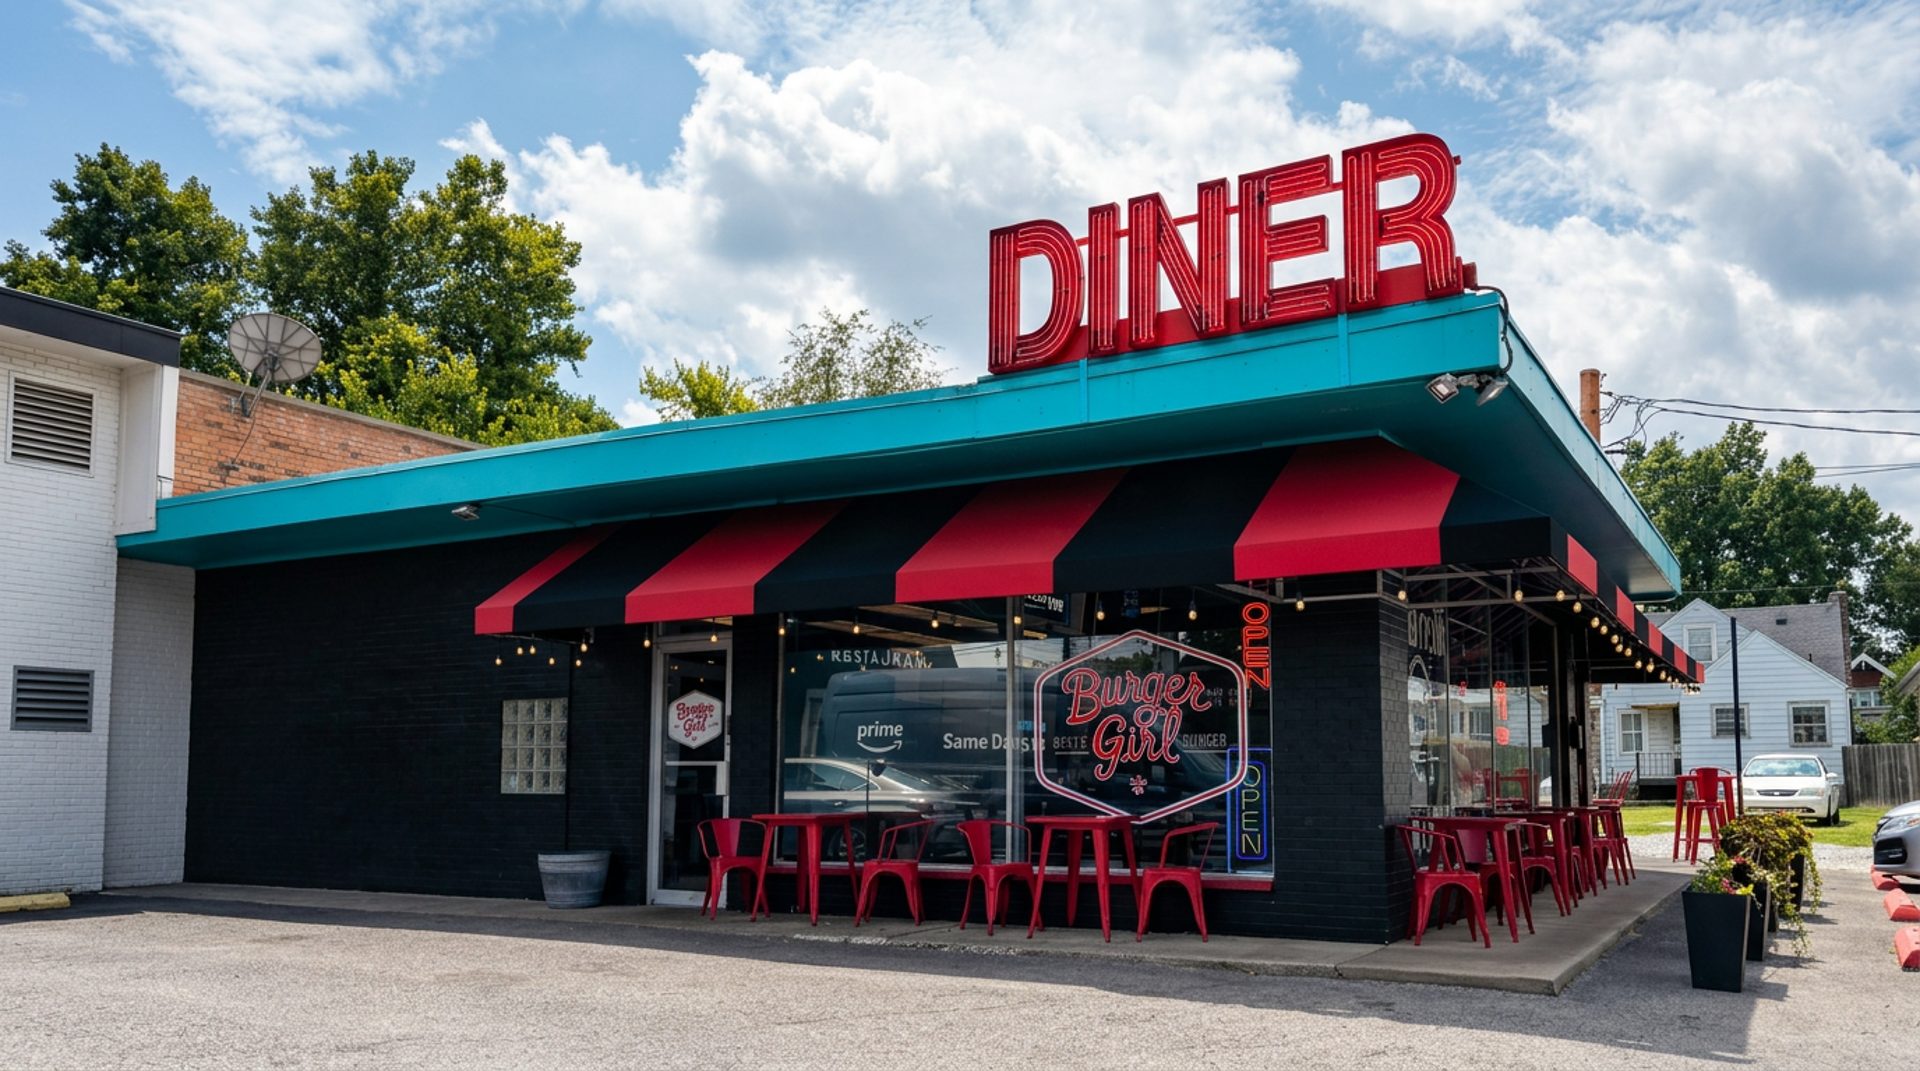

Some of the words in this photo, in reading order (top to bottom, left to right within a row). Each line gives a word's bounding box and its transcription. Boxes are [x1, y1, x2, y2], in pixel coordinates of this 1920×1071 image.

[988, 132, 1463, 375] DINER
[1241, 601, 1271, 690] OPEN
[857, 721, 903, 741] prime
[1061, 667, 1212, 726] Burger
[943, 733, 988, 749] Same
[1092, 704, 1183, 781] Girl
[1241, 765, 1261, 855] OPEN
